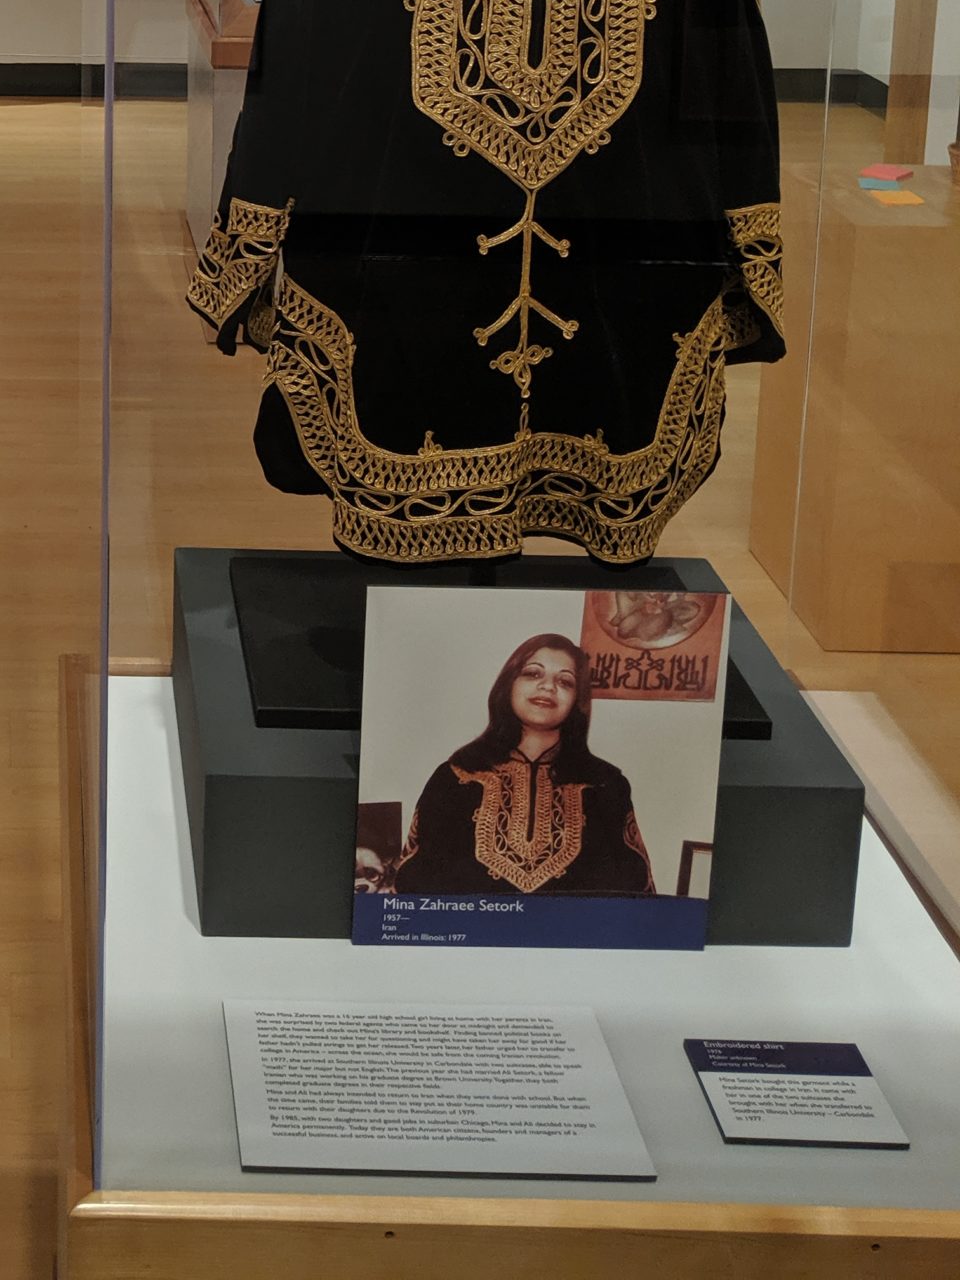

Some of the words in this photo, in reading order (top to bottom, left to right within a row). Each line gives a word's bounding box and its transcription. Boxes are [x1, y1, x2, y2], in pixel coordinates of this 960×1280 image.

[383, 898, 415, 910] Mina
[420, 898, 475, 911] Zahraee
[479, 900, 524, 912] Setork
[381, 933, 410, 941] Arrived
